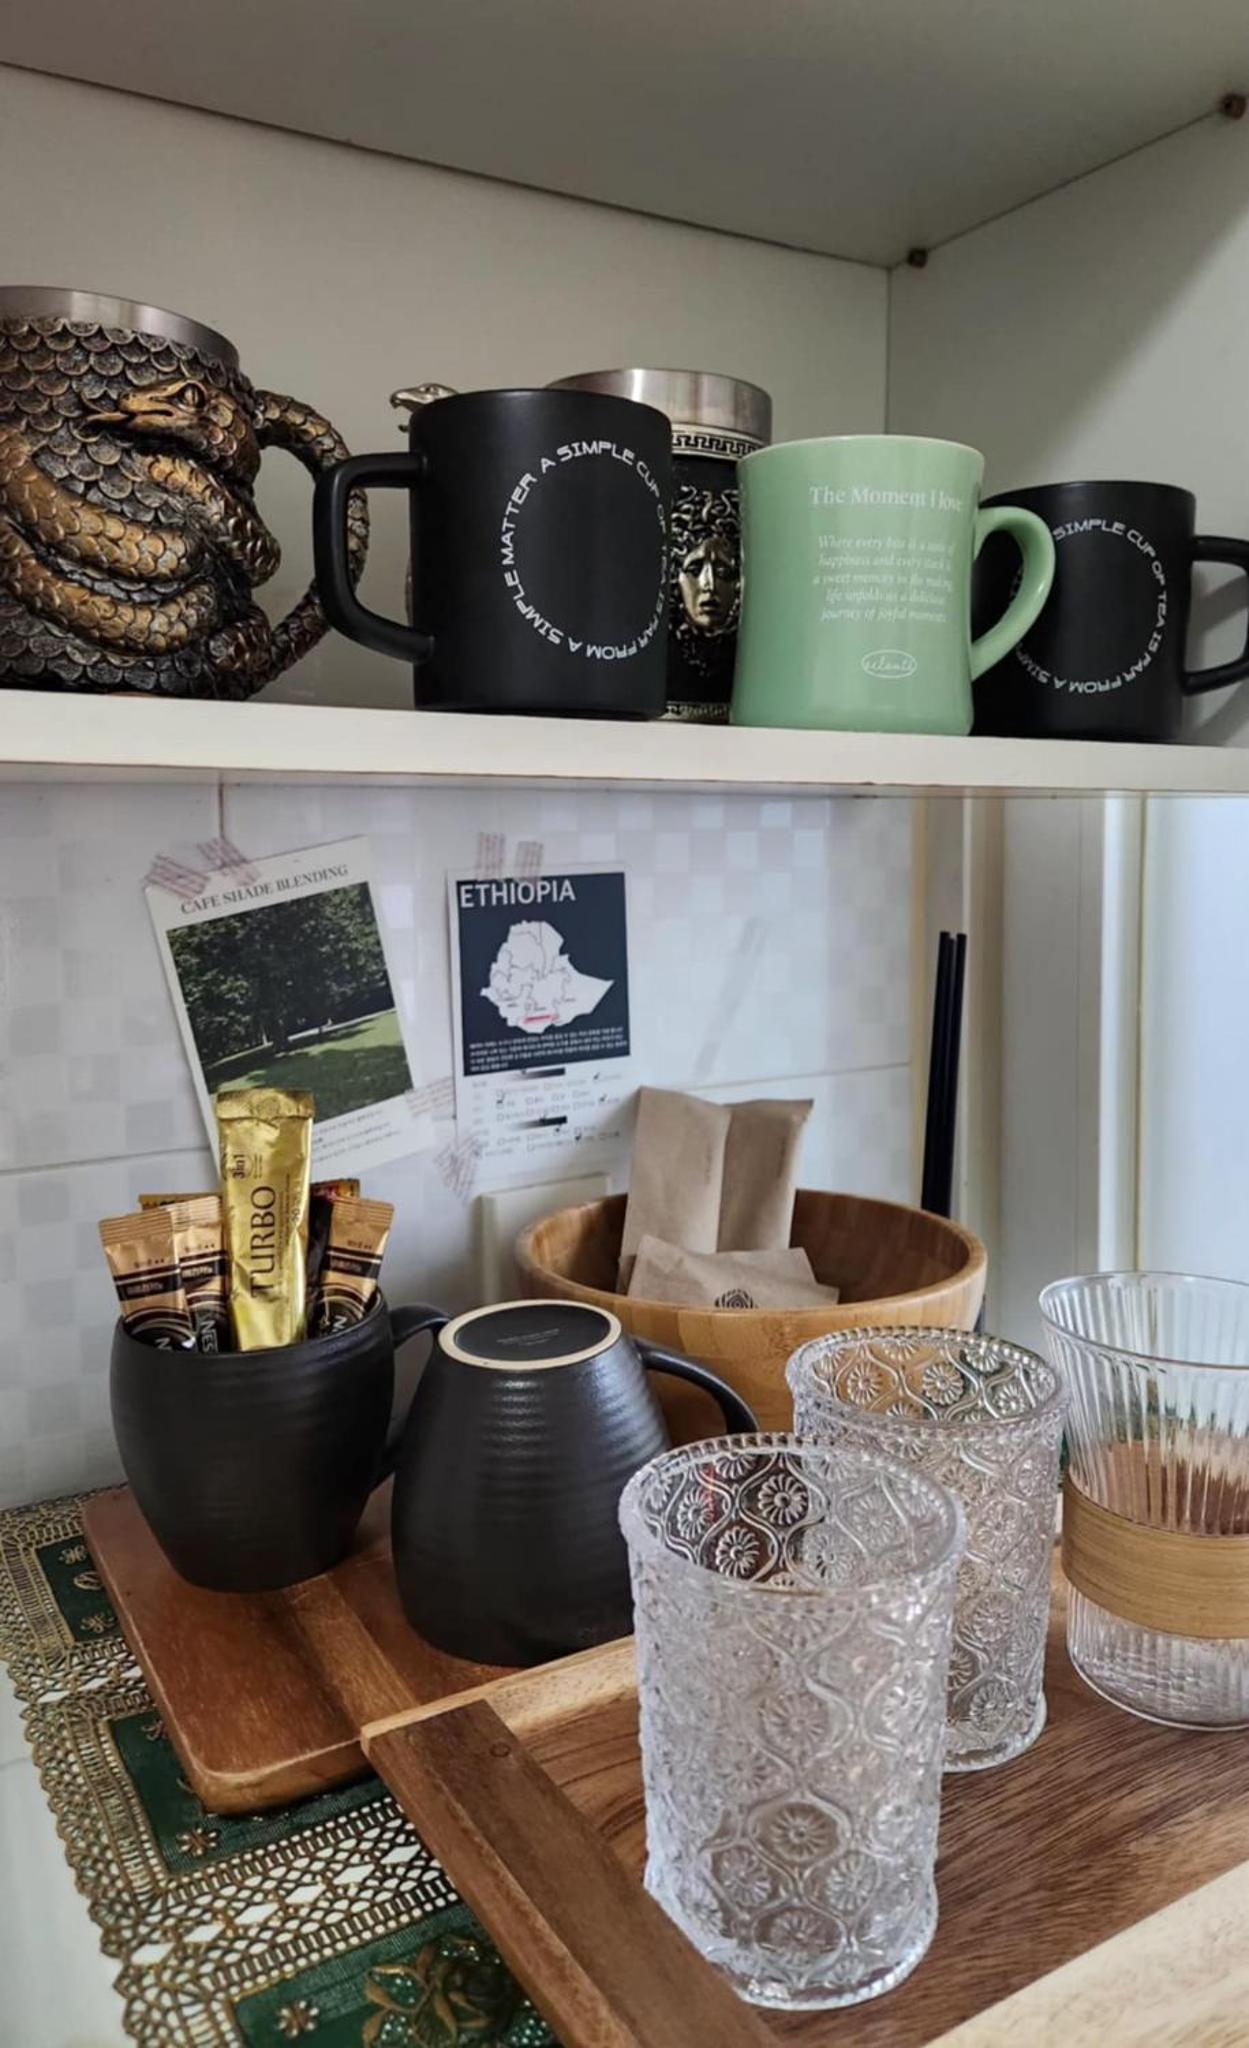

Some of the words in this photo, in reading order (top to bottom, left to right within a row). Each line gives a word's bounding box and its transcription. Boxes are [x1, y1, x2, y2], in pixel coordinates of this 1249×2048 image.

[540, 457, 556, 474] A
[556, 440, 636, 467] SIMPLE
[636, 461, 660, 499] CUP
[809, 486, 847, 505] The
[851, 487, 927, 508] Moment
[500, 472, 538, 566] MATTER
[1052, 518, 1126, 541] SIMPLE
[1126, 529, 1157, 558] CUP
[1151, 561, 1165, 587] OF
[503, 569, 565, 645] SIMPLE
[1156, 590, 1168, 628] TEA
[567, 636, 583, 653] A
[586, 641, 639, 660] FROM
[1147, 631, 1162, 653] IS
[1122, 652, 1152, 682] FAR
[1053, 676, 1067, 689] A
[1068, 675, 1122, 694] FROM
[180, 894, 222, 915] CAFE
[222, 882, 274, 905] SHADE
[276, 864, 349, 892] BLENDING
[460, 879, 577, 909] ETHIOPIA
[250, 1185, 276, 1299] TURBO
[201, 1320, 216, 1353] NES
